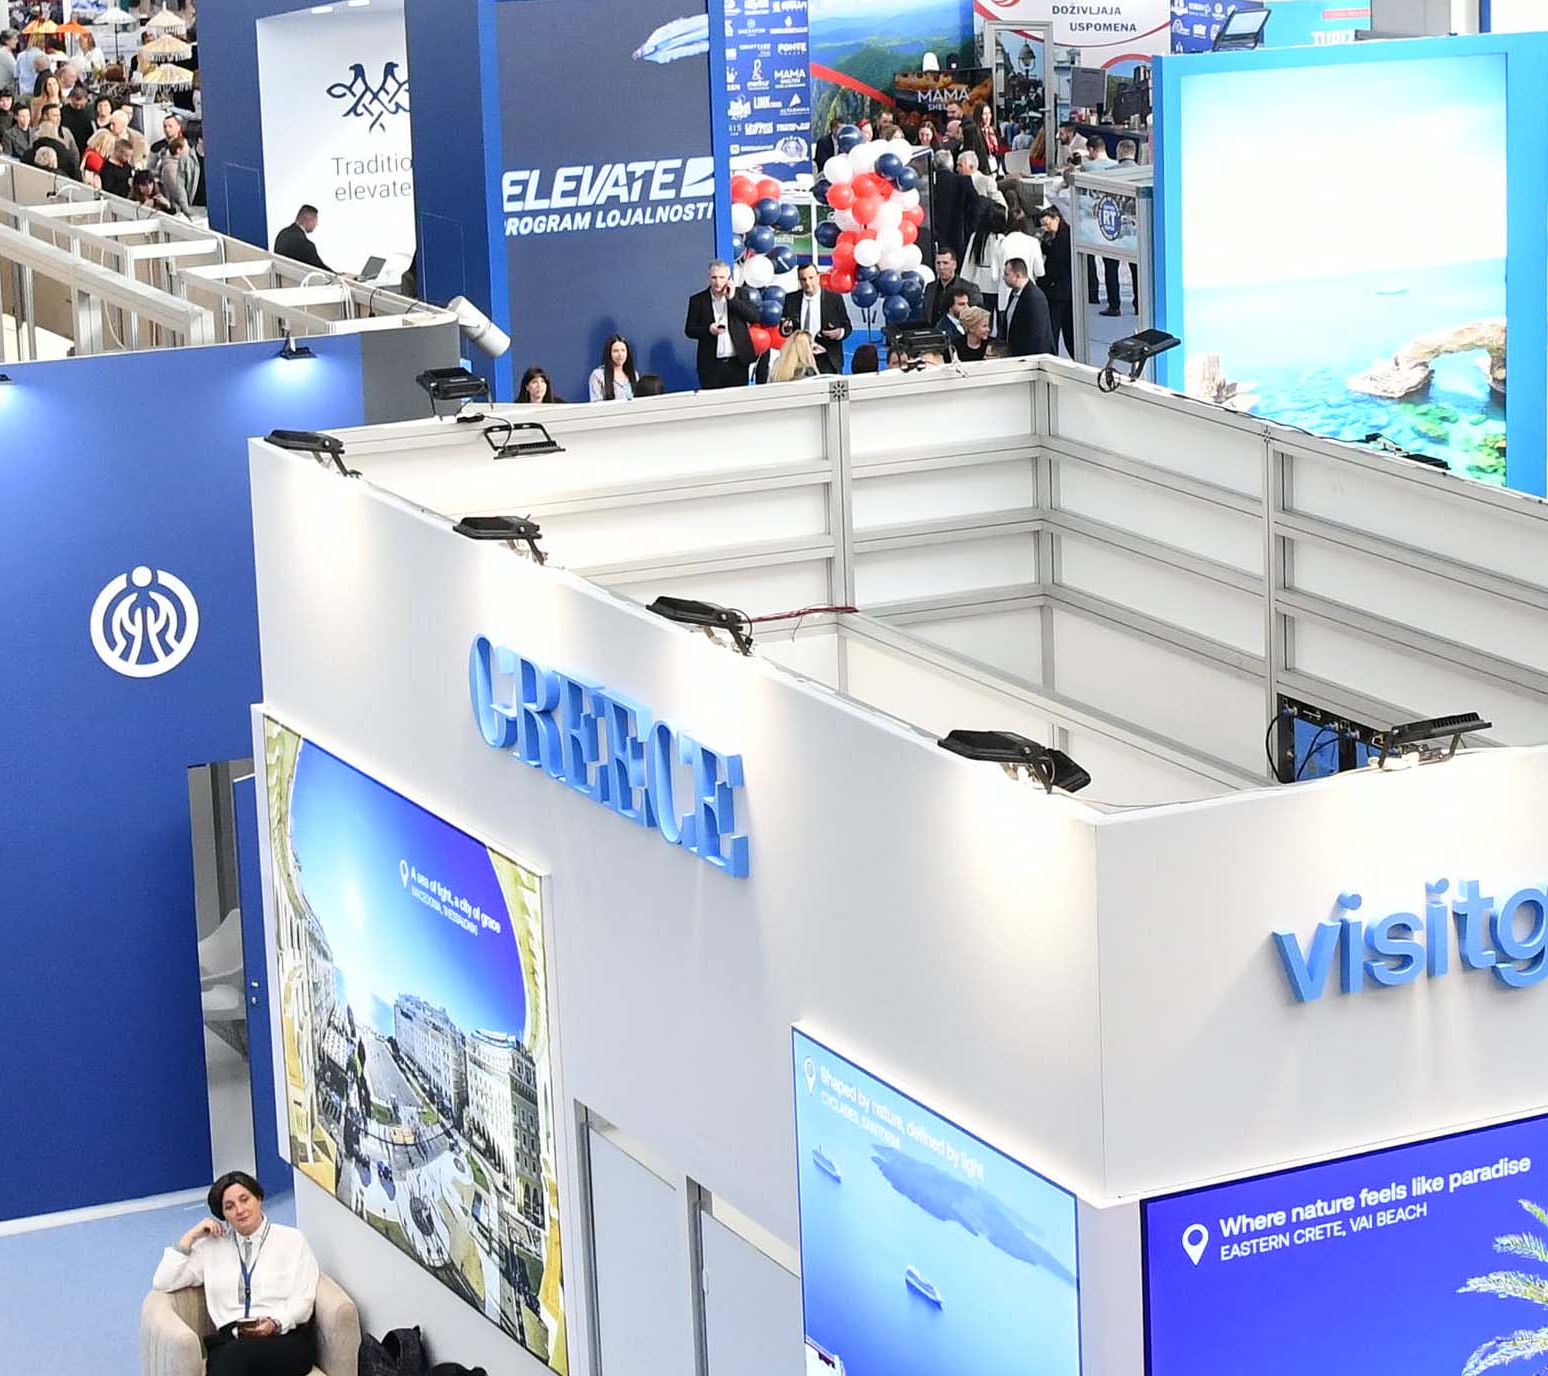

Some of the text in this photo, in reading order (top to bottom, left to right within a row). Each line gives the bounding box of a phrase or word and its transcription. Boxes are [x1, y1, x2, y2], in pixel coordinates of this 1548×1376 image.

[1051, 2, 1122, 16] DOŽIVLJAJA
[1069, 21, 1138, 33] USPOMENA
[774, 69, 806, 81] MAMA
[917, 87, 971, 104] MAMA
[502, 158, 683, 213] ELEVATE
[503, 202, 715, 237] ROGRAM LOJALNOSTI
[468, 632, 750, 879] GREECE
[481, 911, 502, 934] grace
[820, 1064, 859, 1102] Shaped
[858, 1088, 872, 1115] by
[906, 1120, 947, 1156] defined
[946, 1143, 961, 1170] by
[960, 1149, 985, 1181] light
[1219, 1156, 1532, 1238] Where nature feels like paradise
[1219, 1201, 1428, 1261] EASTERN CRETE, VAI BEACH
